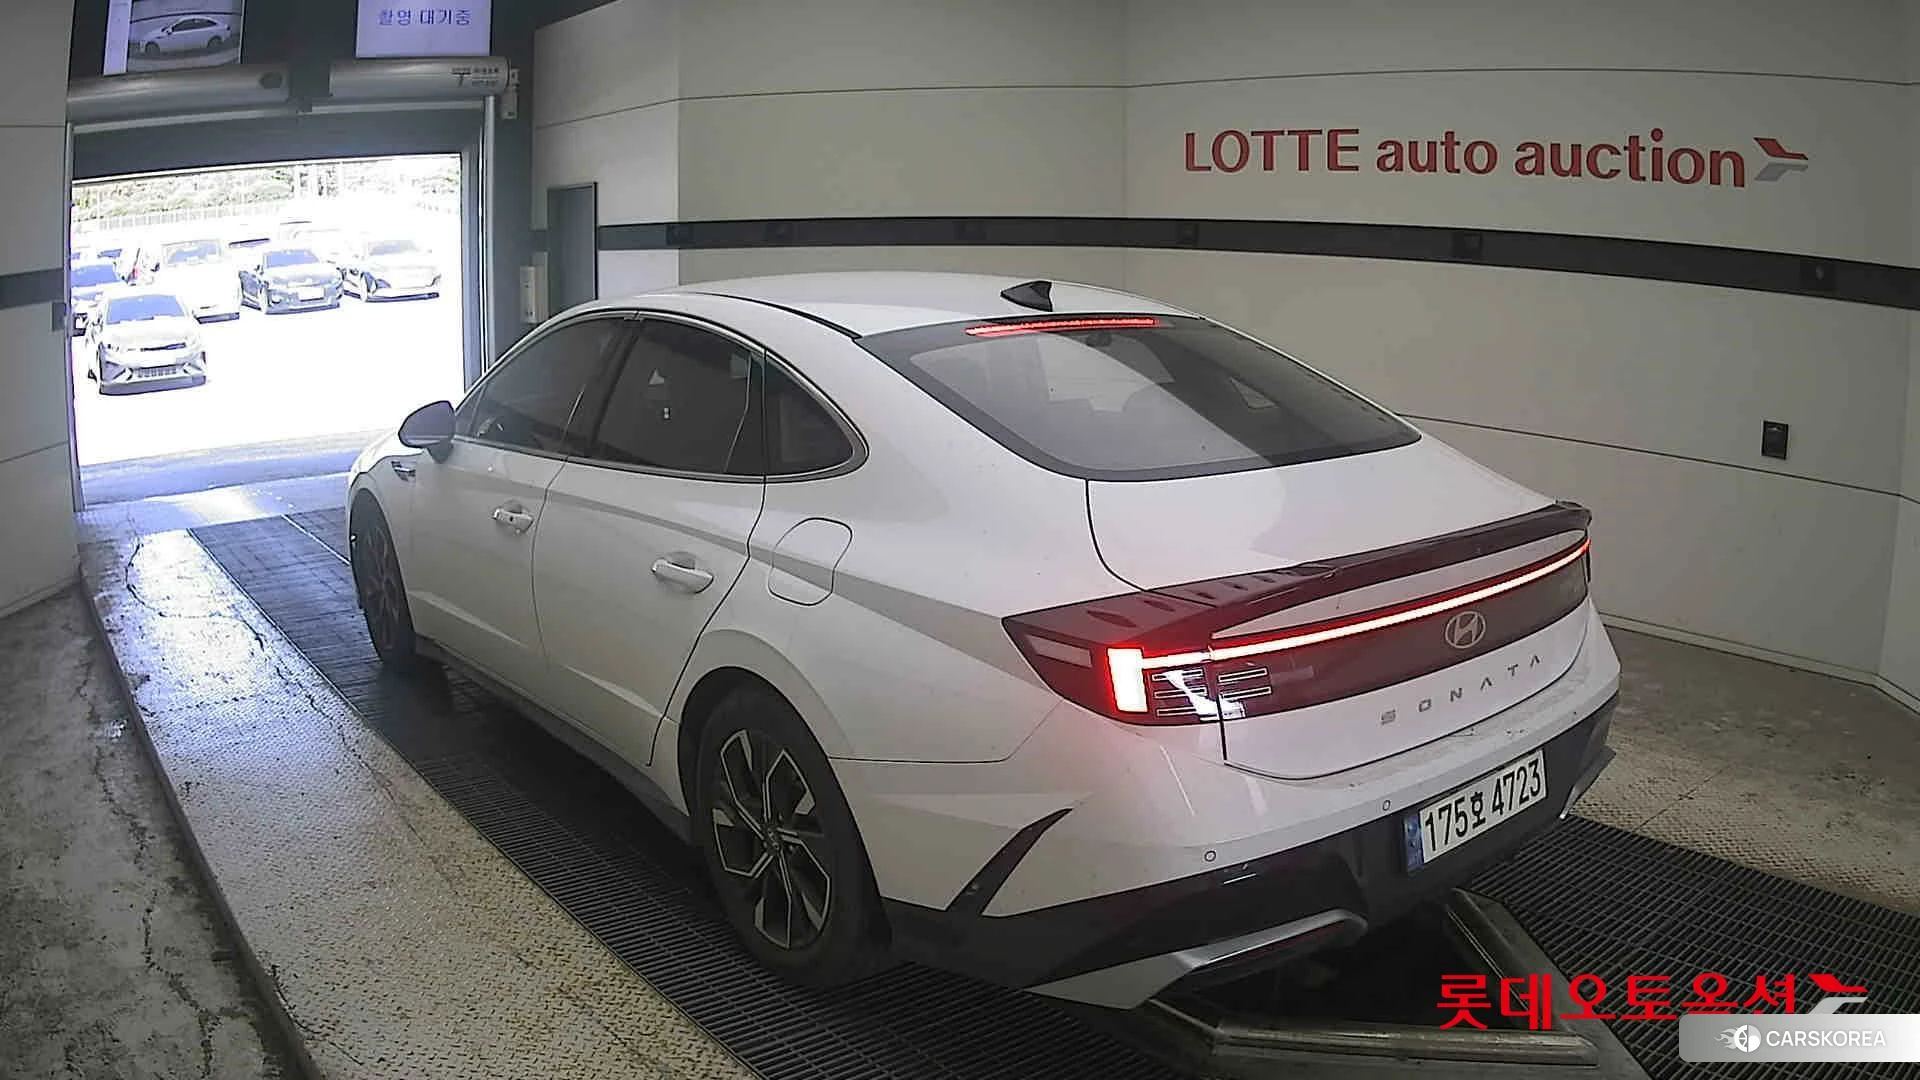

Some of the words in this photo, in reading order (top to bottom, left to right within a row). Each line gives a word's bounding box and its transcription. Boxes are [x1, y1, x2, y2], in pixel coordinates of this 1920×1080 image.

[420, 8, 471, 26] 대기중
[1184, 128, 1360, 173] LOTTE
[1376, 130, 1498, 175] auto
[1514, 127, 1746, 188] auction
[1380, 653, 1541, 725] SONATA
[1491, 758, 1542, 817] 4723
